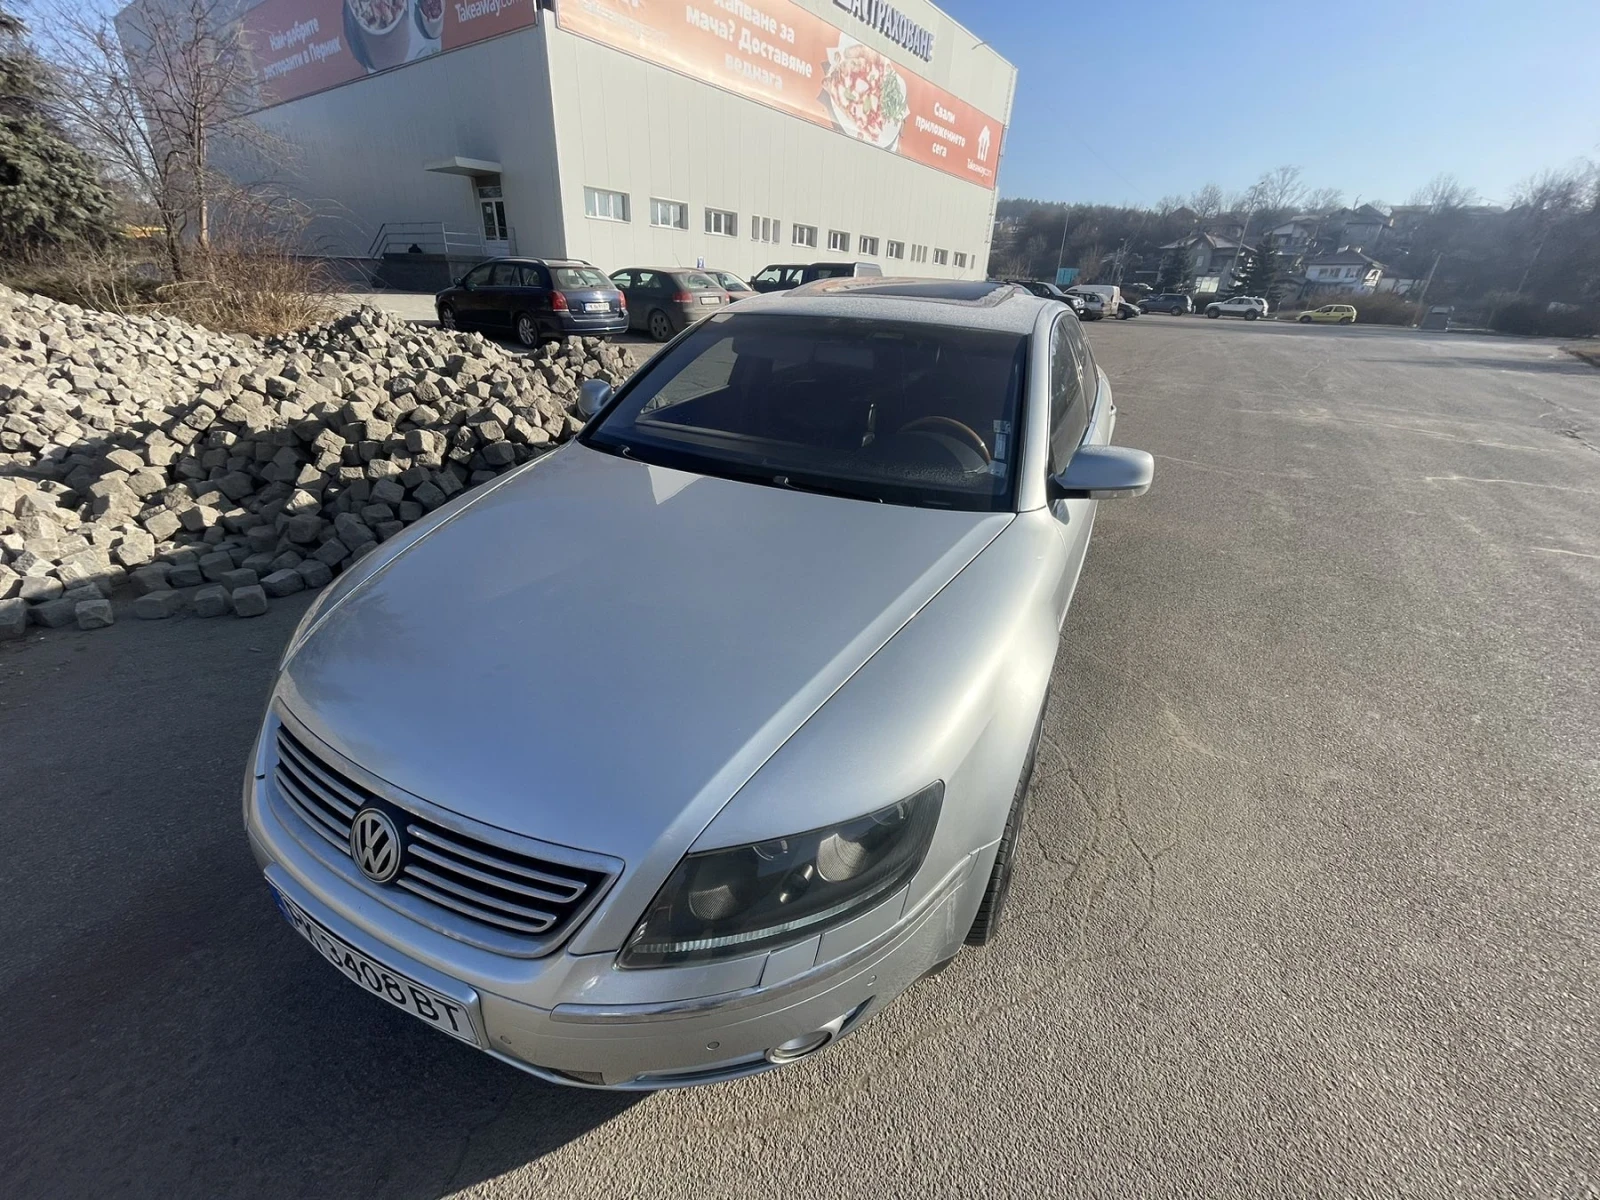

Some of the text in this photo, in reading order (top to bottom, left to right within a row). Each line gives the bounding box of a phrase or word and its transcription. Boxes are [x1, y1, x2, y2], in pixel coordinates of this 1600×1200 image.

[779, 23, 795, 44] за
[834, 0, 935, 63] АСТРАХОВАНЕ
[738, 26, 813, 78] Доставяме
[725, 53, 783, 91] веднага
[934, 101, 956, 125] Свали
[932, 142, 948, 158] сега
